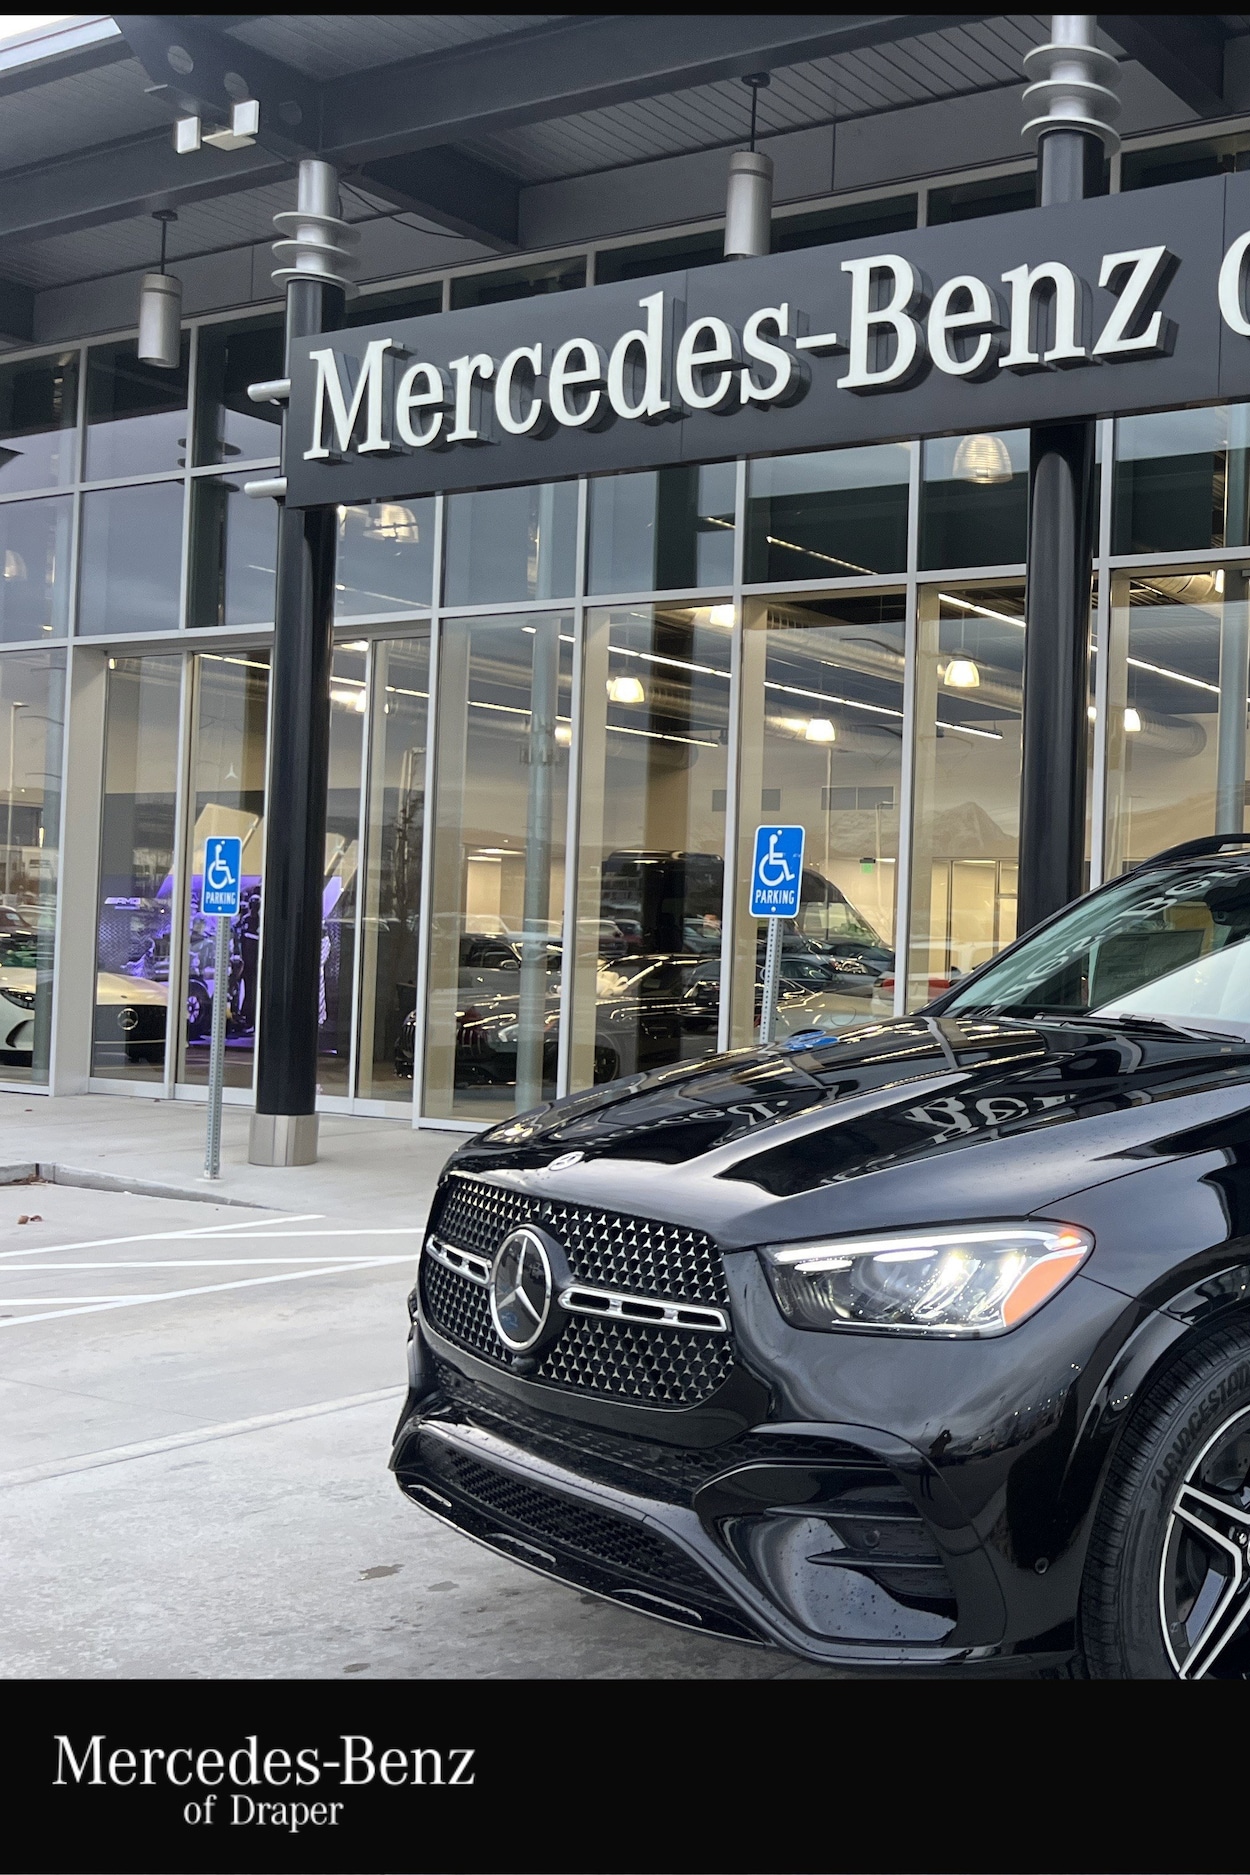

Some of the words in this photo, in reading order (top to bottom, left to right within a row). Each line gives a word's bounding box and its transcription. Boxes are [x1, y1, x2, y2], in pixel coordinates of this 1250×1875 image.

[303, 245, 1166, 461] Mercedes-Benz
[205, 891, 236, 905] PARKING
[754, 889, 795, 905] PARKING
